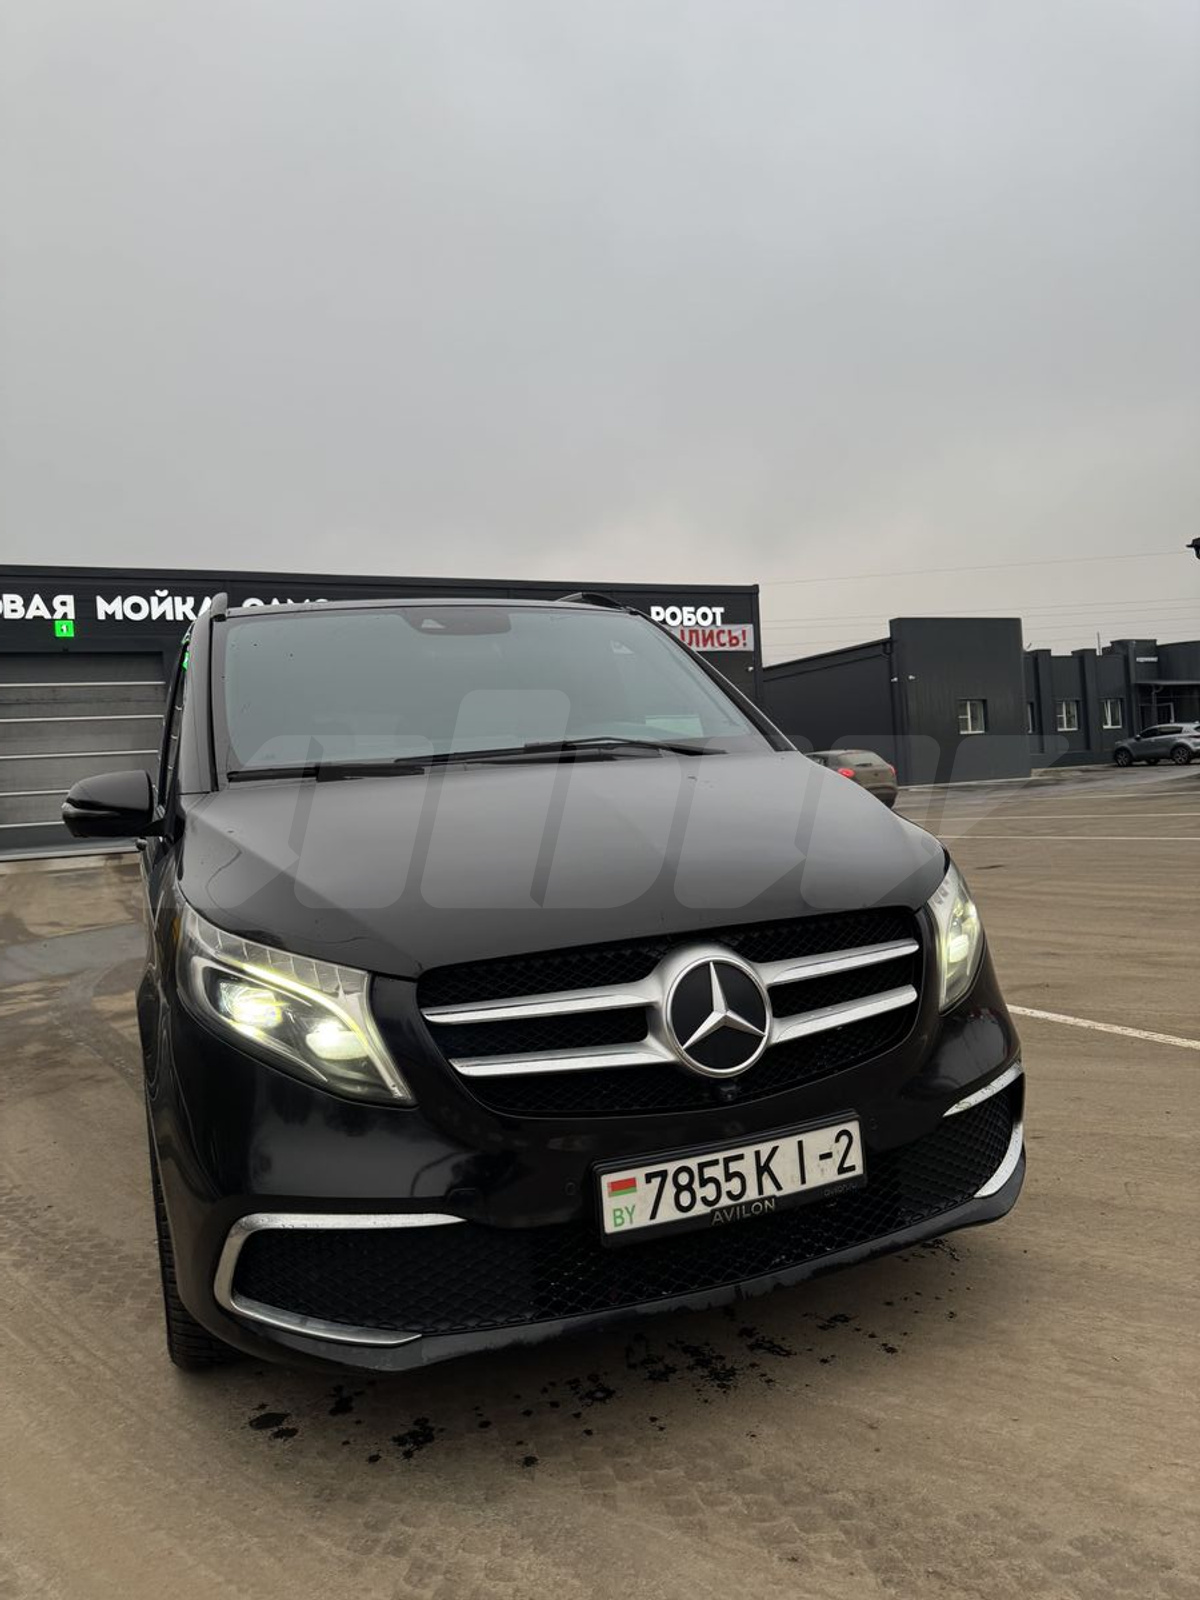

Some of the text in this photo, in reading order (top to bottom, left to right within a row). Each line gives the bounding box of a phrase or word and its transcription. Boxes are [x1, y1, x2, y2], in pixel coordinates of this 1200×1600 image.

[0, 593, 75, 619] ВАЯ
[650, 606, 725, 626] РОБОТ
[680, 629, 747, 647] ЛИСЬ!
[613, 1205, 636, 1228] BY
[711, 1199, 776, 1226] AVILON
